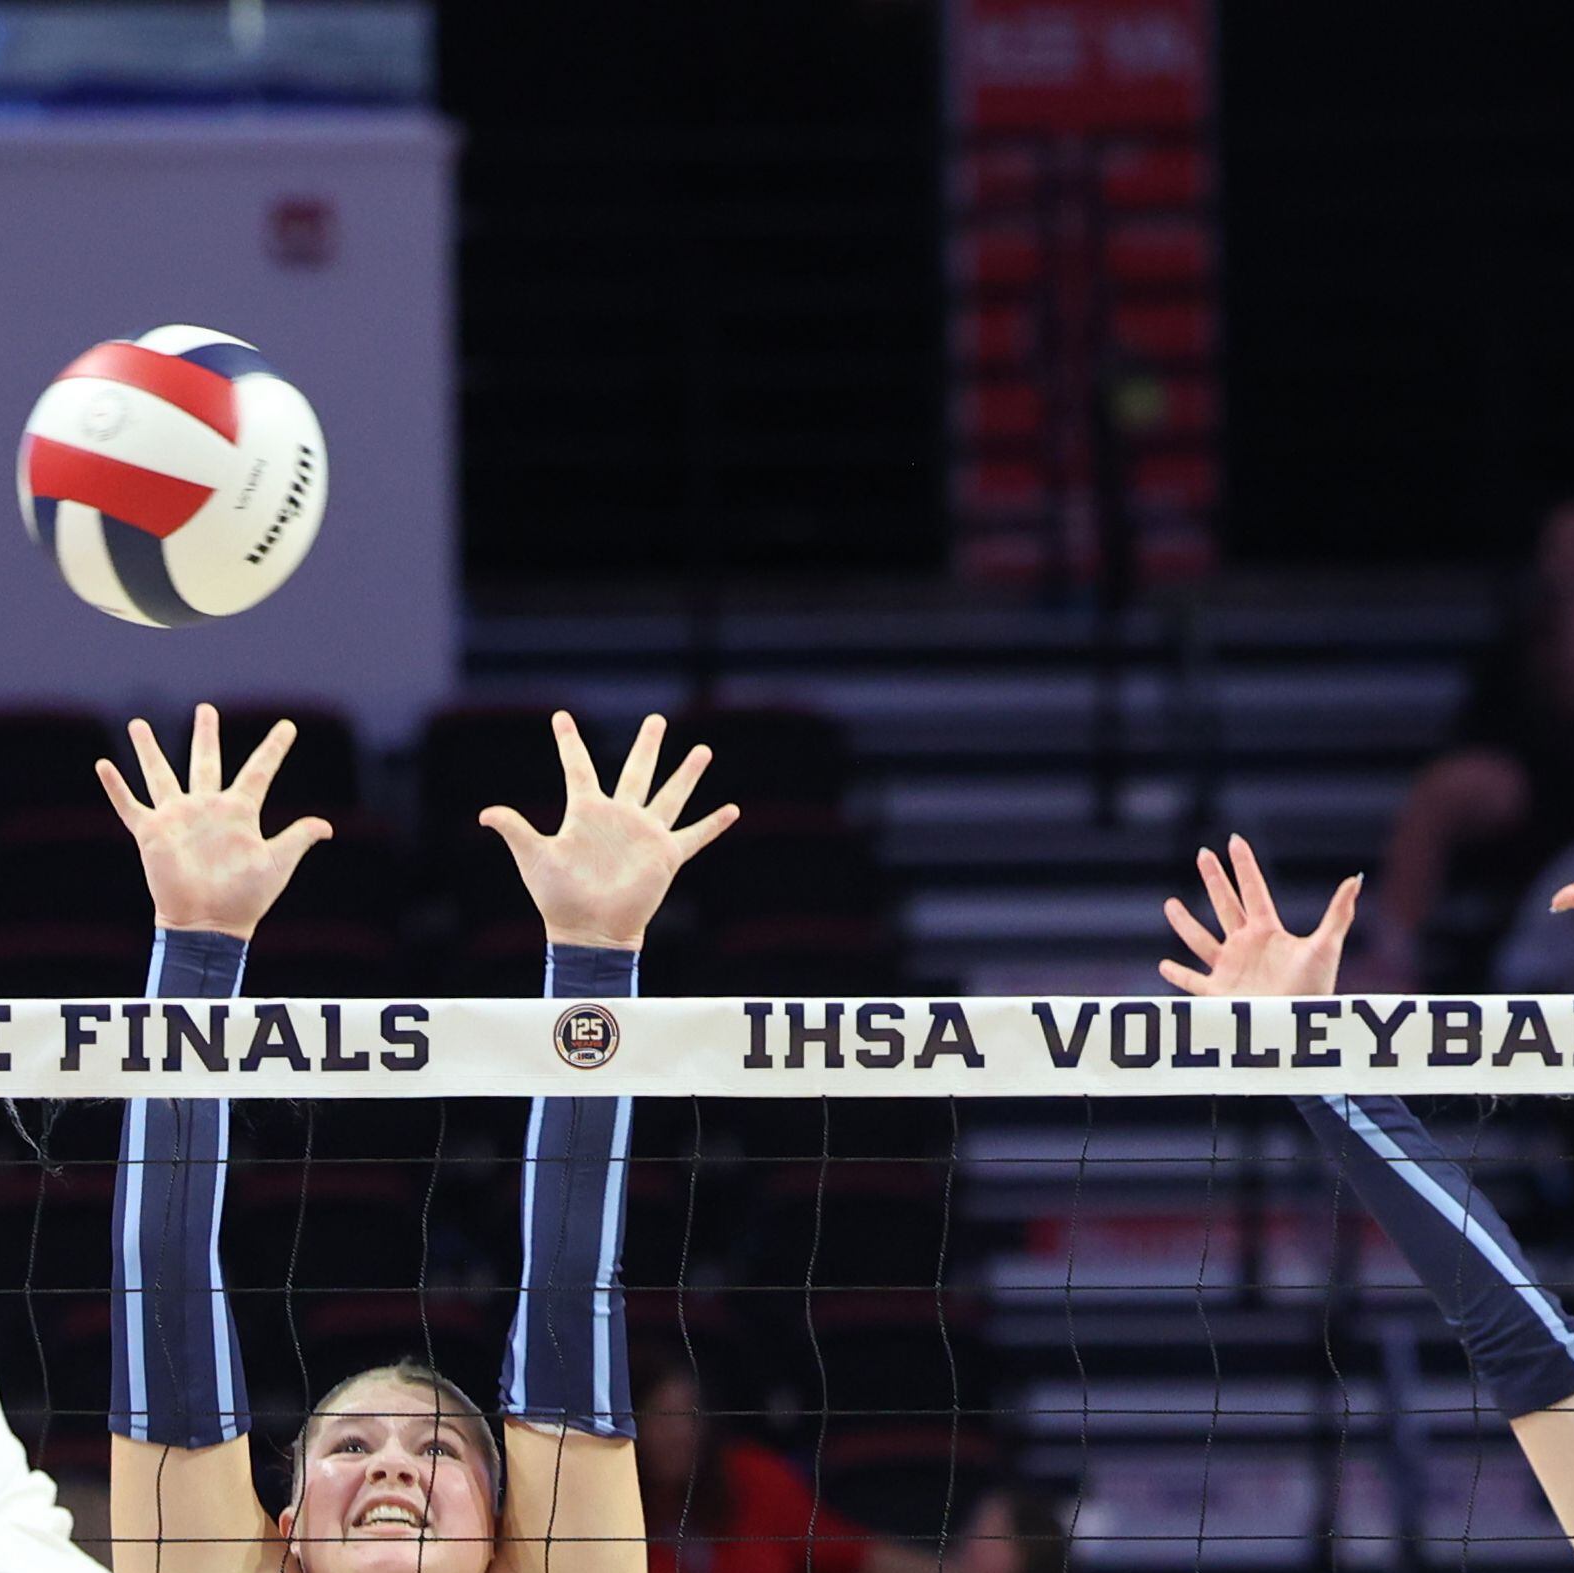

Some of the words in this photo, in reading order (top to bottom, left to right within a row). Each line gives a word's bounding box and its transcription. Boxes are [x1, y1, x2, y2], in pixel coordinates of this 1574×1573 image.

[61, 1003, 430, 1072] FINALS
[570, 1017, 604, 1041] 125
[744, 1002, 984, 1069] IHSA
